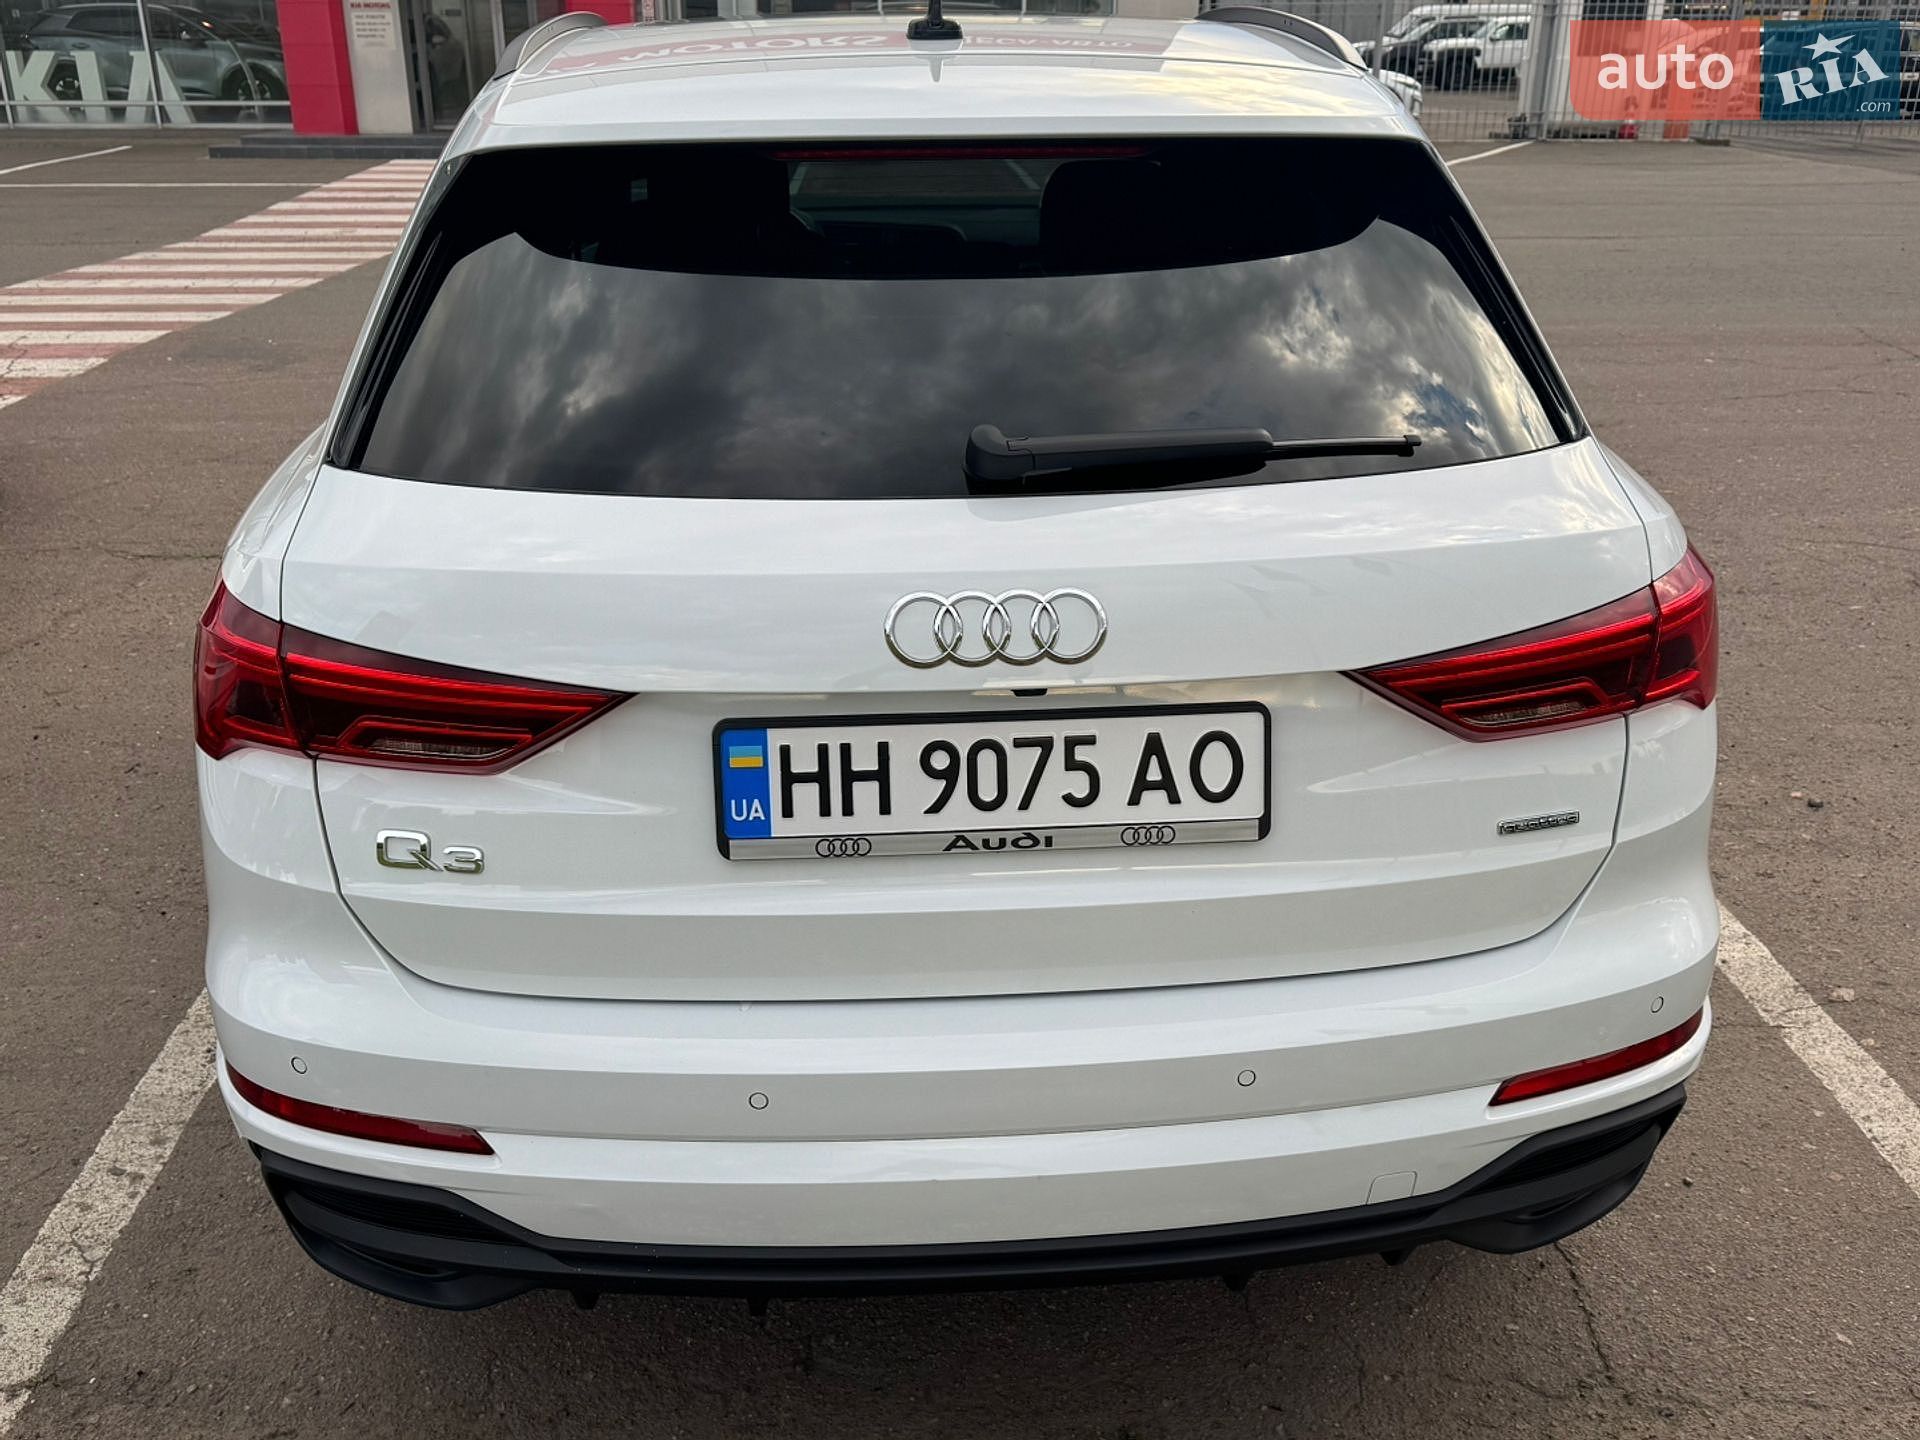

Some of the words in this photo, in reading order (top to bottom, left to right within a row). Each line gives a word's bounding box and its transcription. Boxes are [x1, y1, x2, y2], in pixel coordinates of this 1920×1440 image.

[5, 51, 196, 124] KIA
[779, 741, 891, 818] HH
[919, 735, 1101, 814] 9075
[1127, 730, 1244, 806] AO
[730, 798, 766, 821] UA
[376, 829, 485, 874] Q3
[942, 831, 1053, 851] Audi
